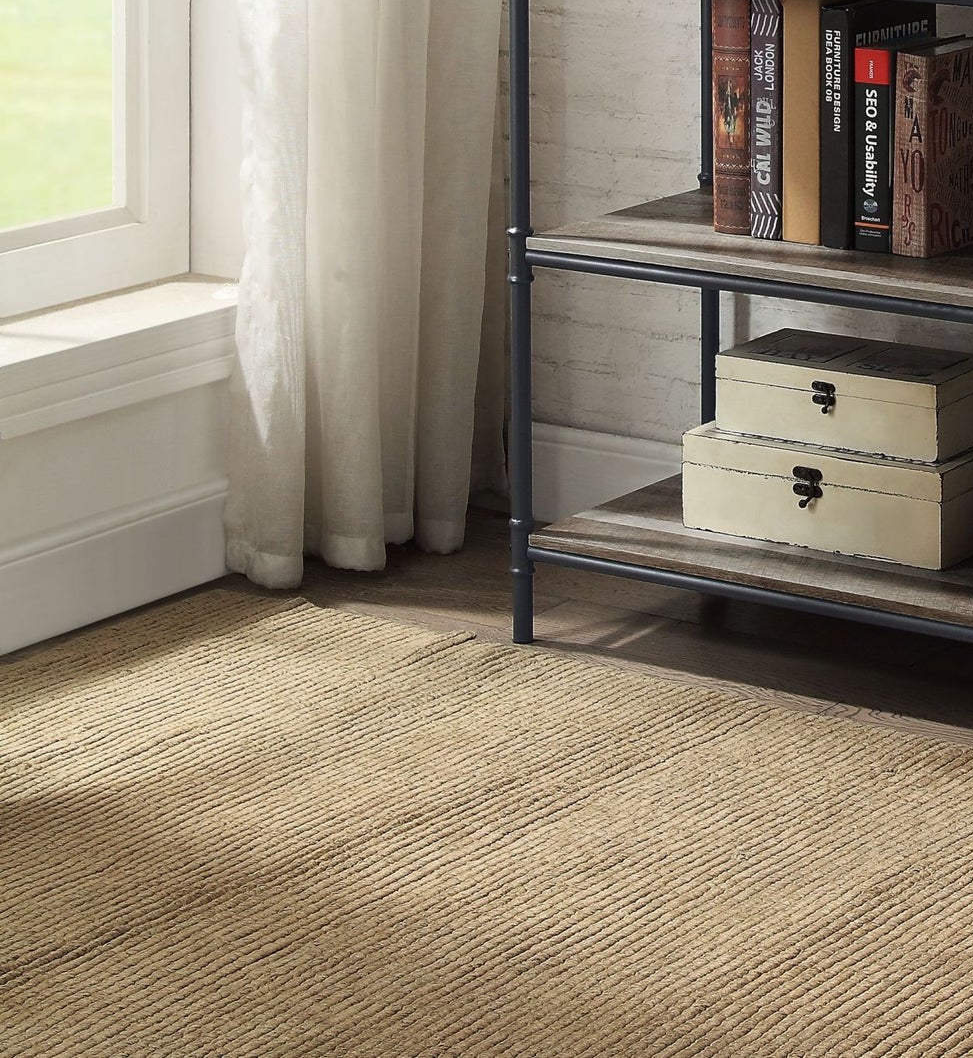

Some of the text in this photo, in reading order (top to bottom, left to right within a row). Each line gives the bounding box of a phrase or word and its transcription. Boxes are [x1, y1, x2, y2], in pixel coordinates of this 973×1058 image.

[753, 49, 764, 81] JACK
[764, 43, 775, 91] LONDON
[825, 29, 833, 102] IDEA BOOK 08
[833, 30, 841, 132] FURNITURE DESIGN
[862, 89, 878, 197] SEO & Usability
